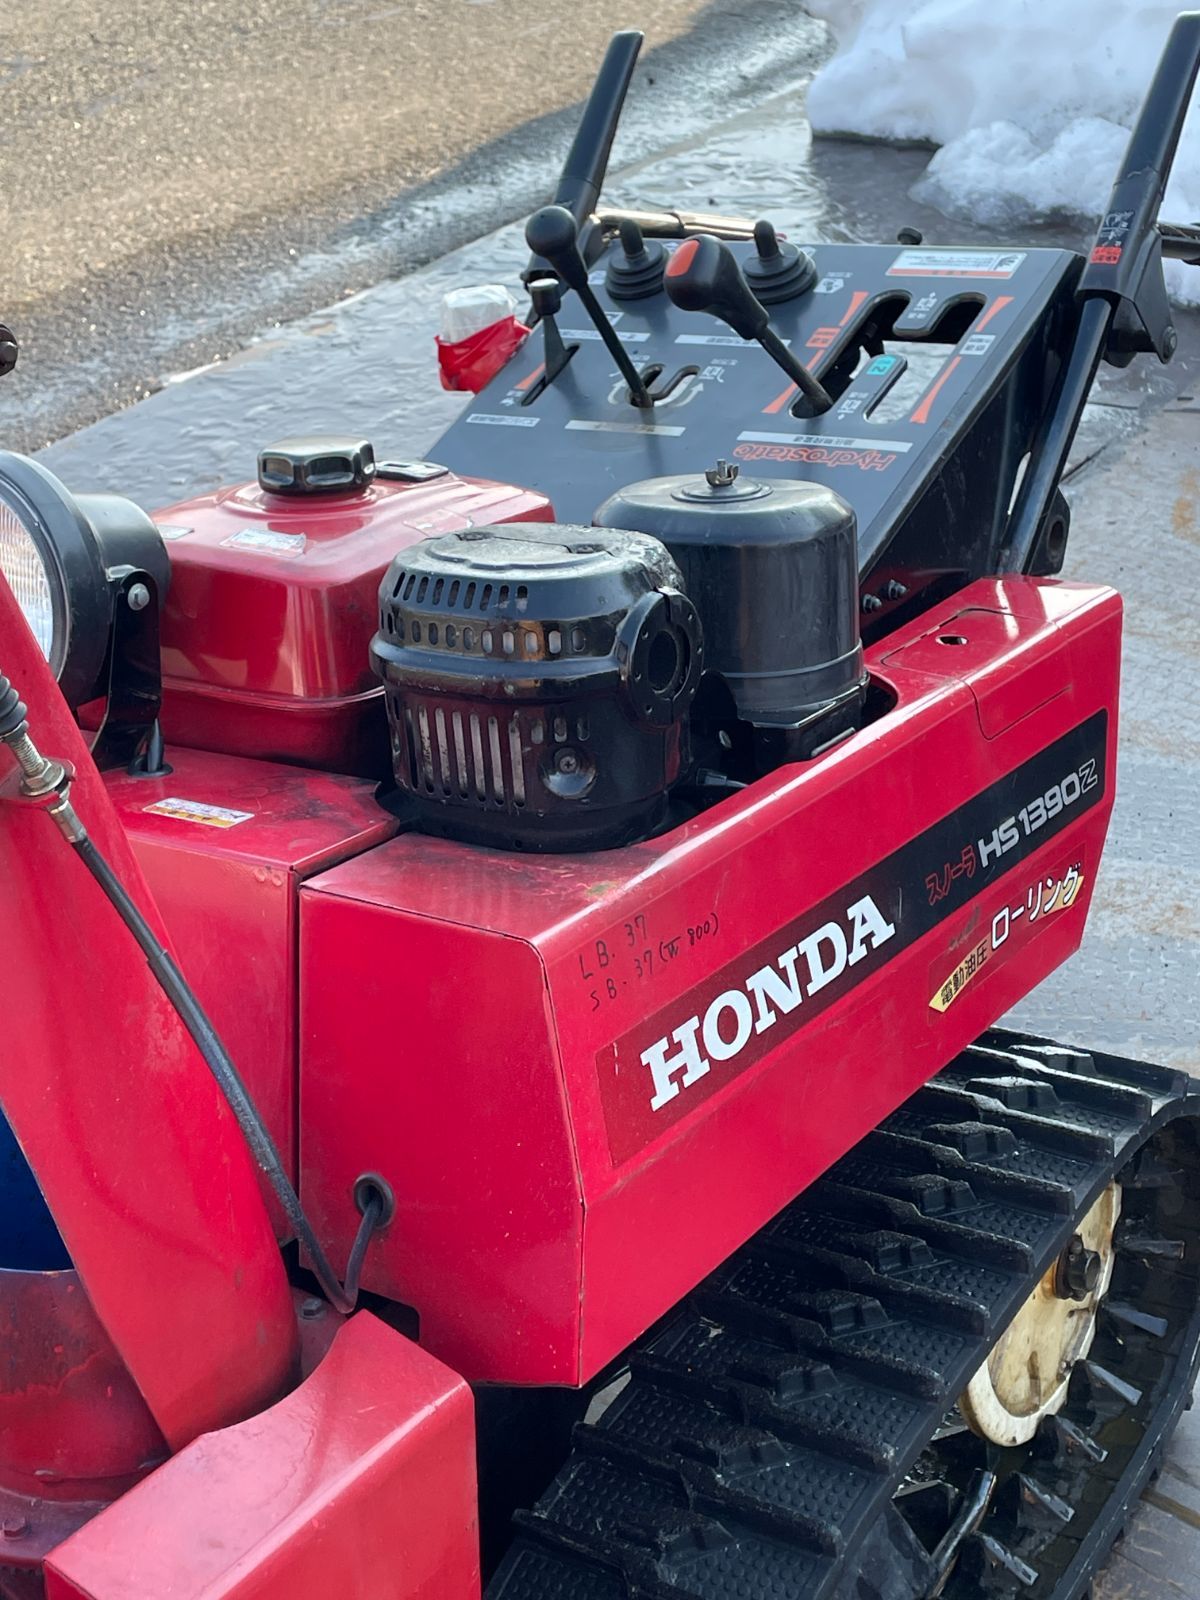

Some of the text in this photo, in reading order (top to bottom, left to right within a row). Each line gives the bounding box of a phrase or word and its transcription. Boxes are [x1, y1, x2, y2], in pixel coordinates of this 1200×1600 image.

[733, 444, 897, 471] Hydrostatic
[925, 757, 1098, 906] スノーラ HS1390Z
[624, 914, 647, 947] 37
[940, 862, 1081, 1006] 電動油圧 ローリング
[639, 894, 896, 1112] HONDA
